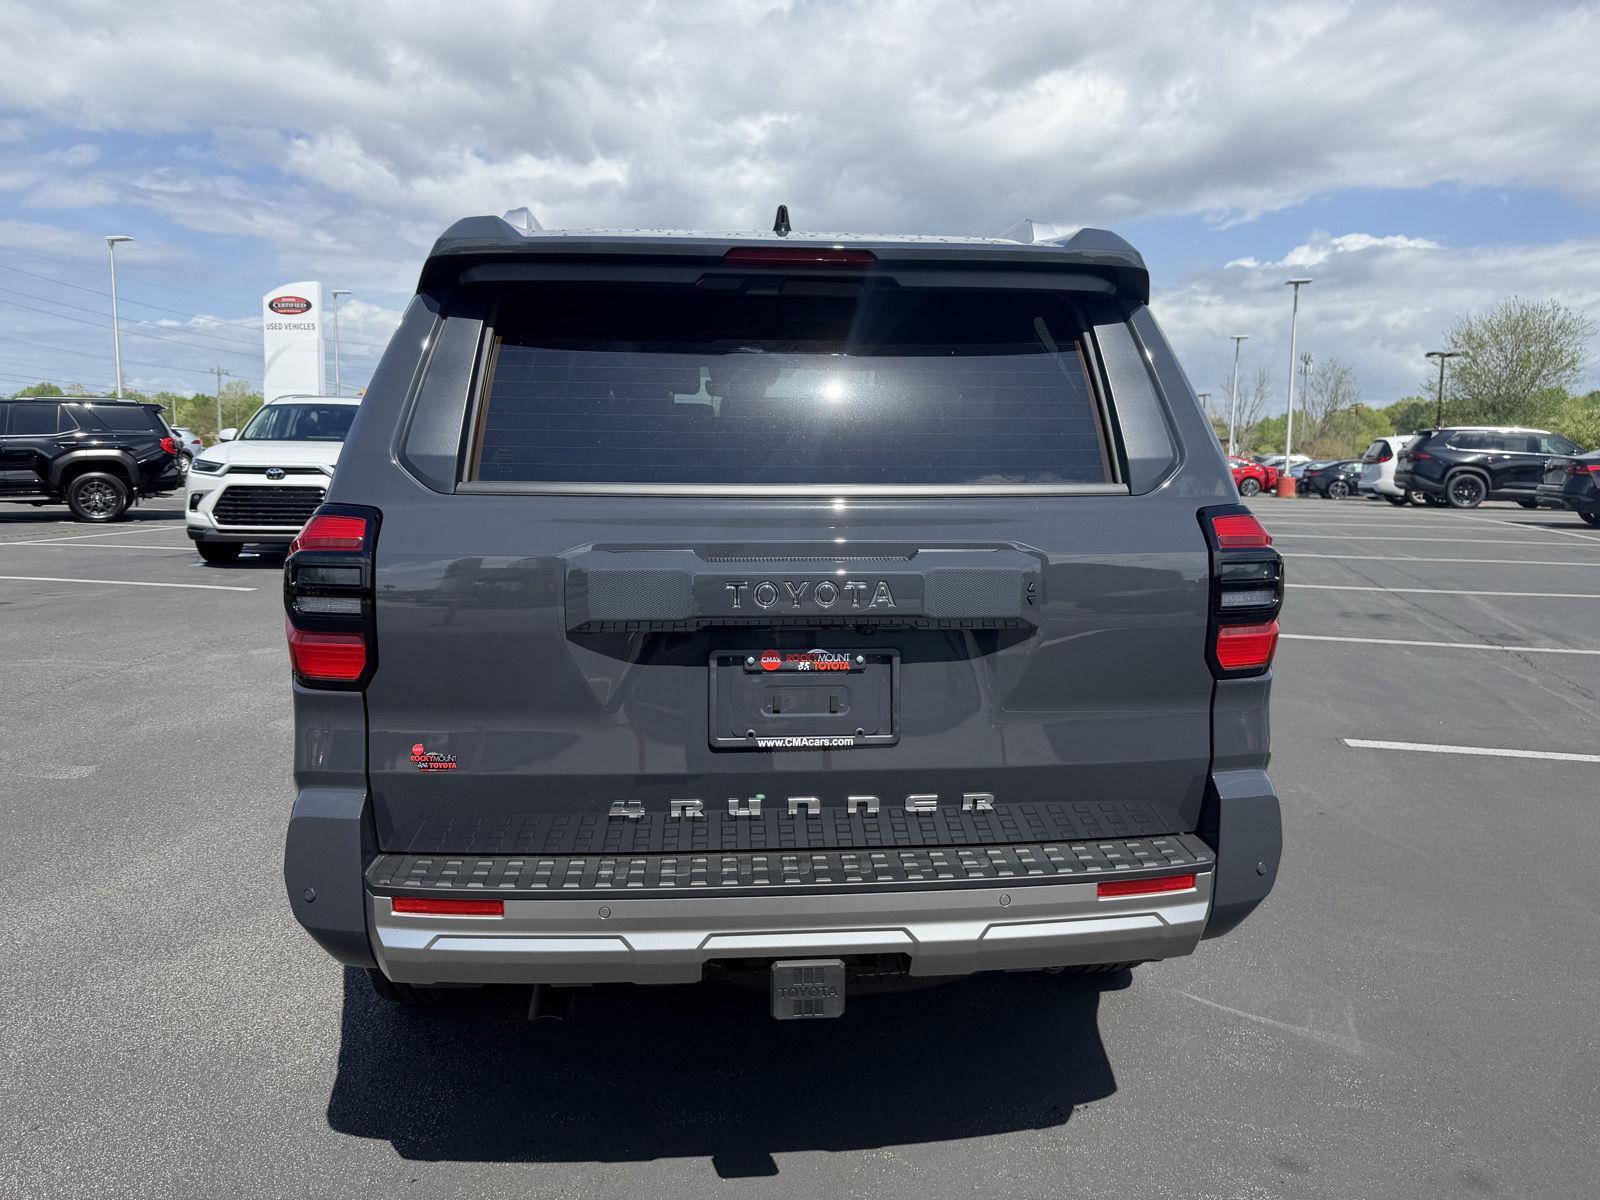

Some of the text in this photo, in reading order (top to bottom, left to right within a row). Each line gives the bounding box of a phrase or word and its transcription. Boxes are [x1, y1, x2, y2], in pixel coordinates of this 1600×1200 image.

[265, 322, 316, 331] USED VEHICLES
[724, 580, 897, 609] TOYOTA
[813, 661, 851, 671] TOYOTA
[757, 737, 854, 748] www.CMAcars.com
[778, 985, 839, 999] TOYOTA
